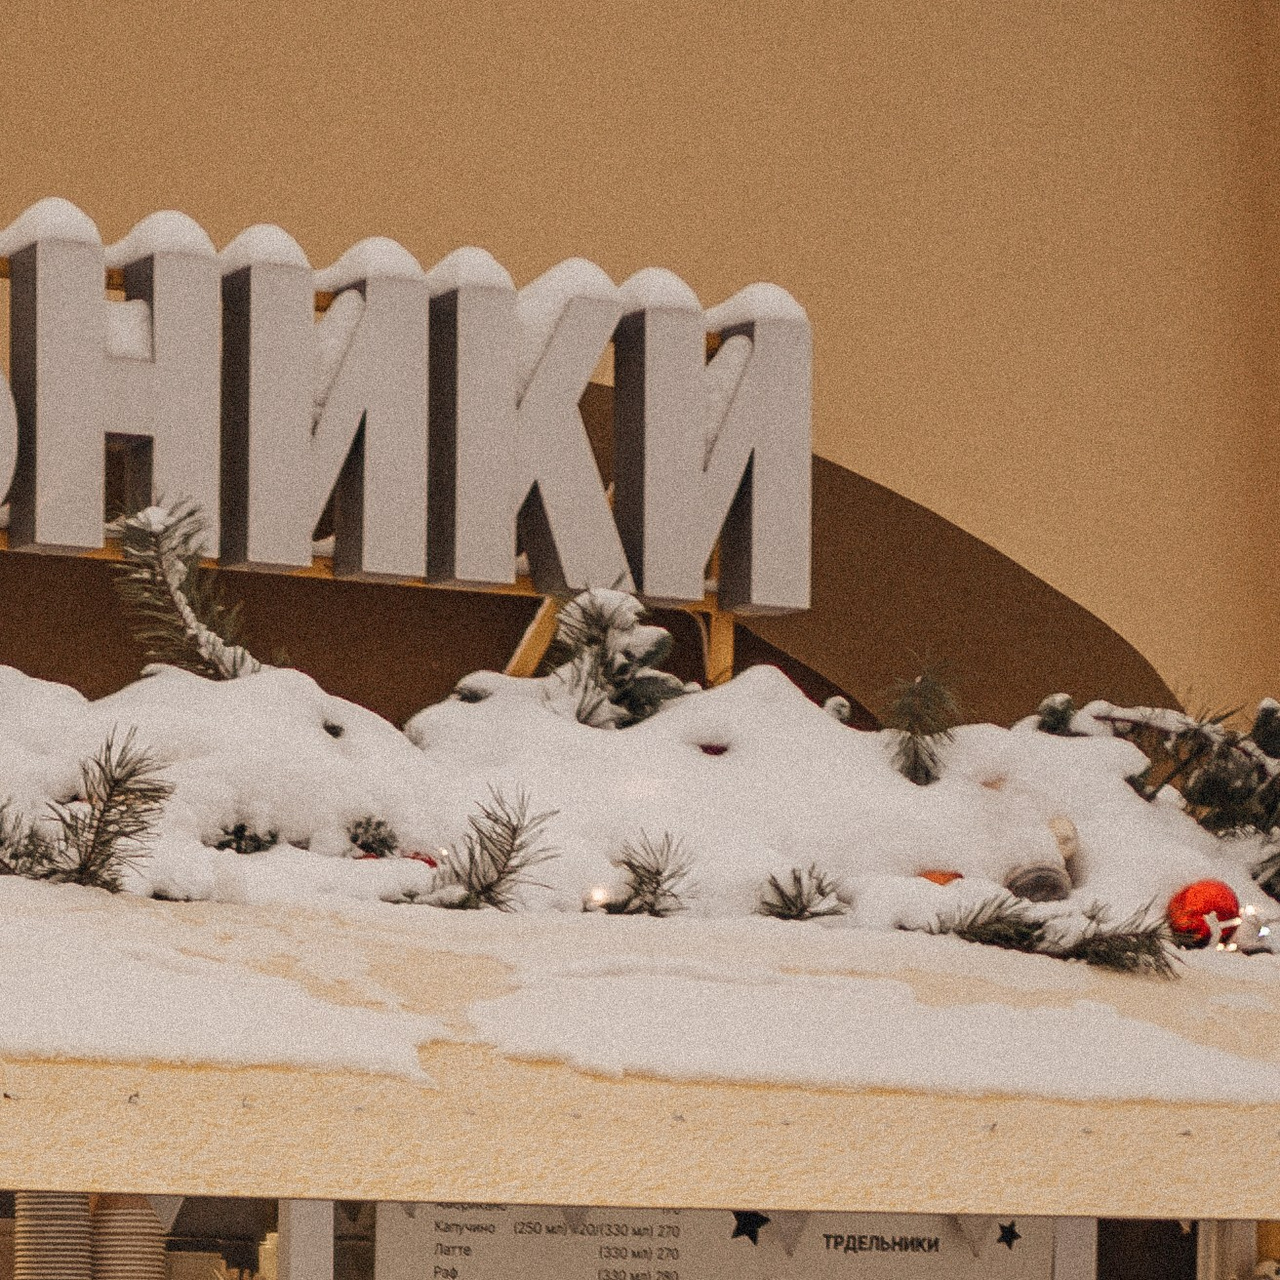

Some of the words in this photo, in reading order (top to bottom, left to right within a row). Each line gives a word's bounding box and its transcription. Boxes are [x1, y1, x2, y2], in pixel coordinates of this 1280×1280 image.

[433, 1221, 497, 1237] Капучино
[513, 1221, 543, 1237] (250
[657, 1225, 680, 1240] 270
[433, 1242, 473, 1258] Латте
[598, 1246, 628, 1262] (330
[657, 1247, 680, 1262] 270
[823, 1233, 940, 1254] ТРДЕЛЬНИКИ
[433, 1265, 458, 1280] Раф
